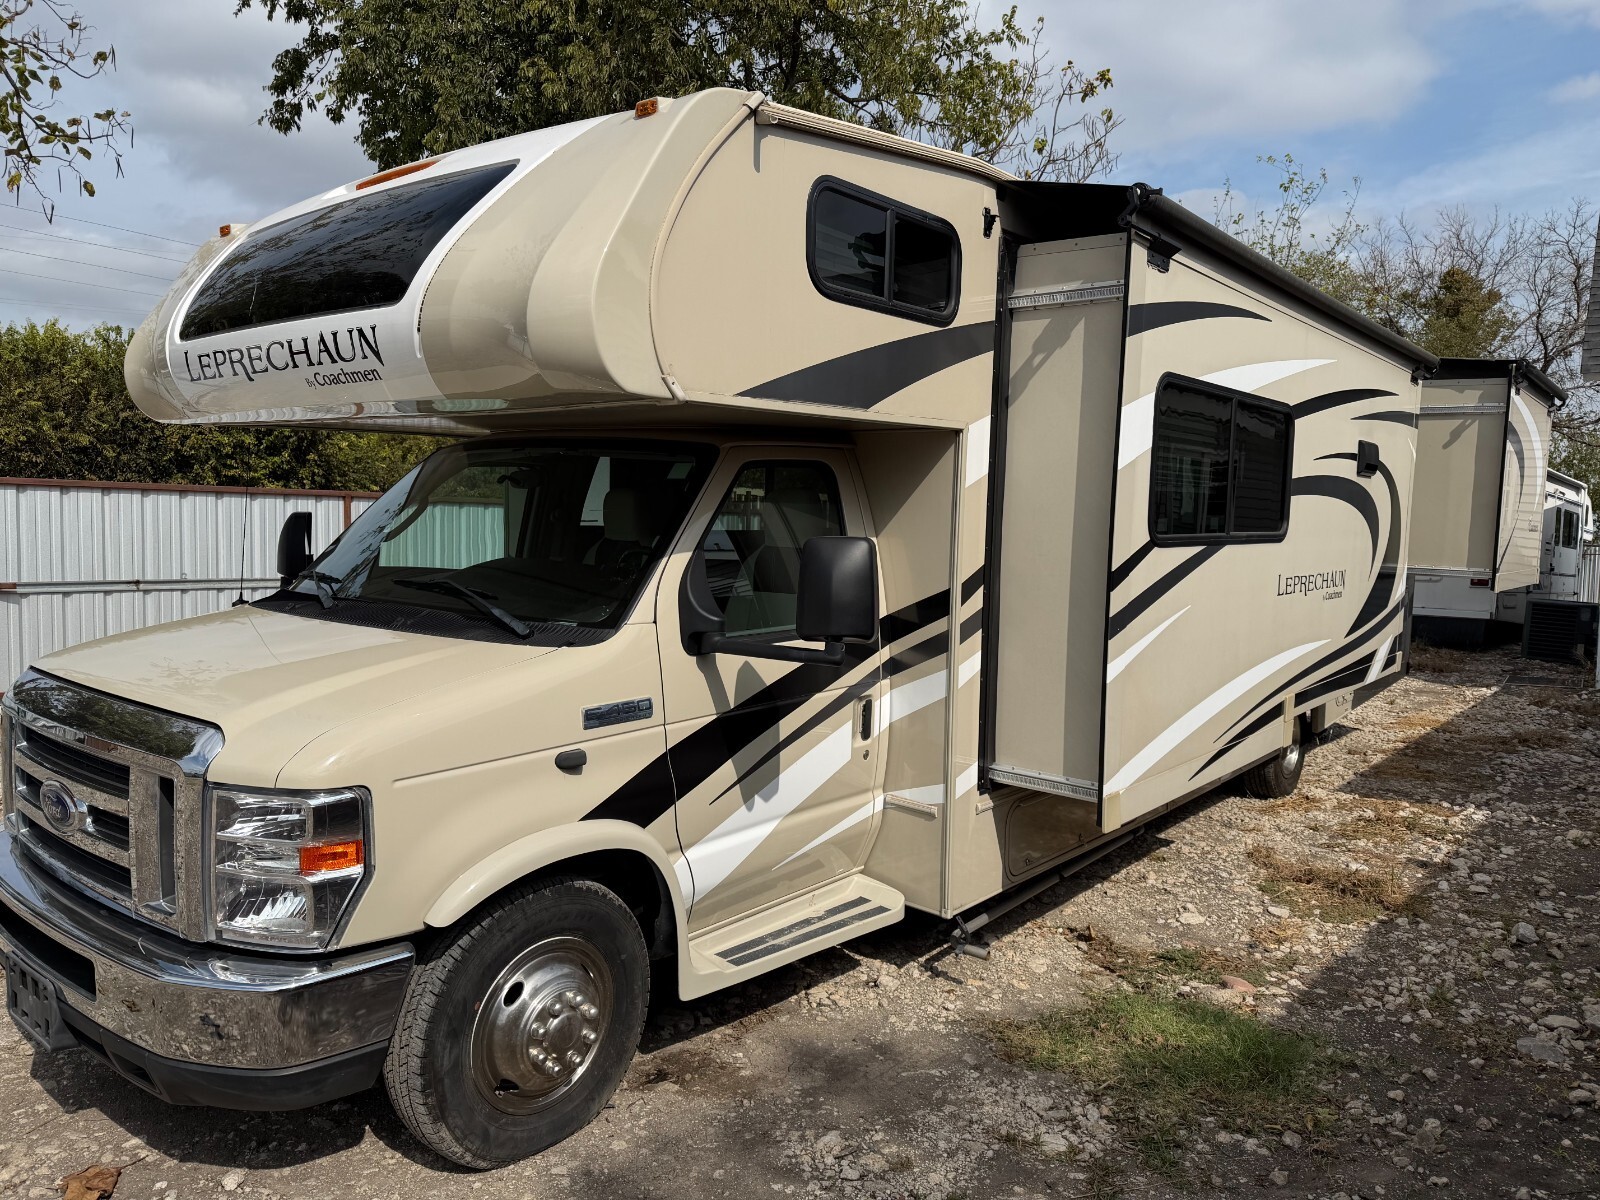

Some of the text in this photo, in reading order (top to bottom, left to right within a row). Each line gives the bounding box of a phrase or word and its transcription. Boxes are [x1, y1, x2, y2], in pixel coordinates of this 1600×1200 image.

[184, 323, 385, 382] LEPRECHAUN
[305, 368, 383, 390] By Coachmen
[1276, 569, 1347, 597] LEPRECHAUN
[43, 793, 62, 818] Ford
